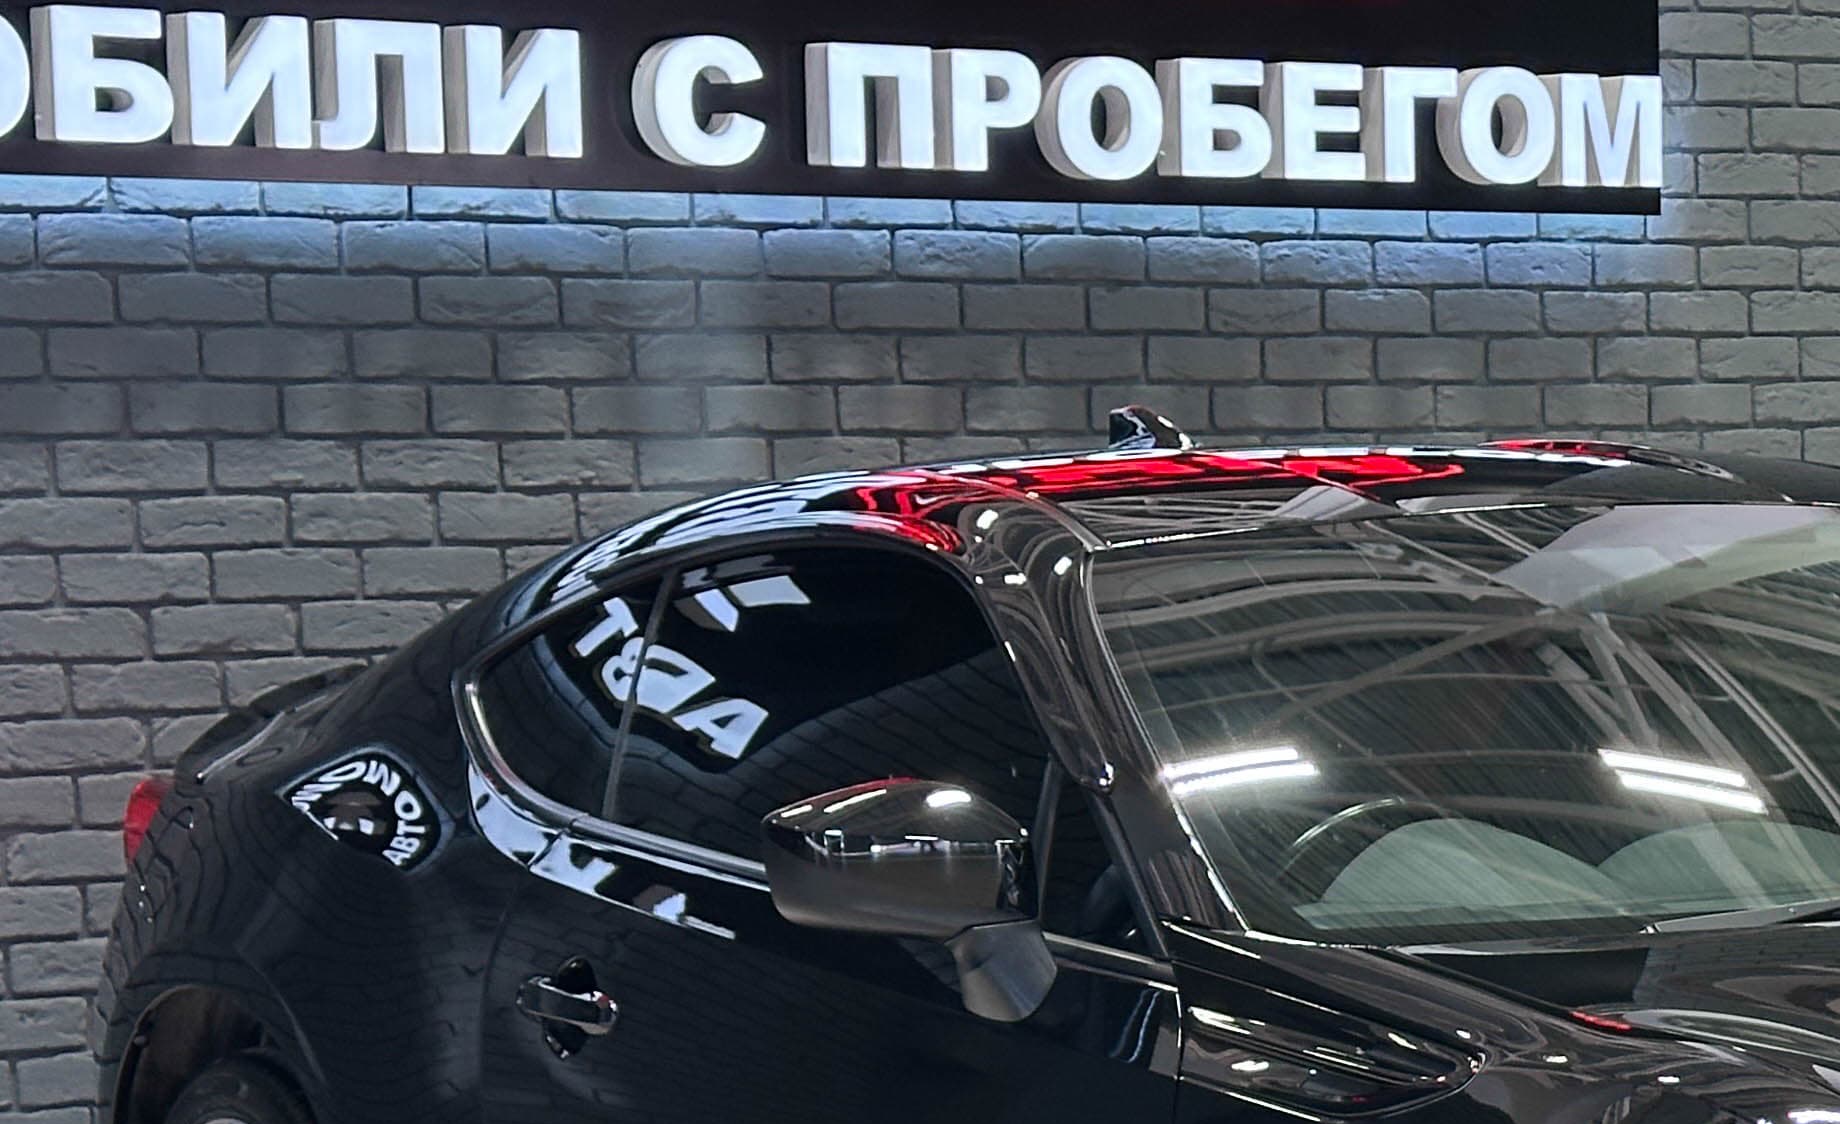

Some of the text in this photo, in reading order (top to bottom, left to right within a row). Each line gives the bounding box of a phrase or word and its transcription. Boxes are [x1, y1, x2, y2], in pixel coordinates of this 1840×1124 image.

[0, 4, 1663, 189] БИЛИ С ПРОБЕГОМ
